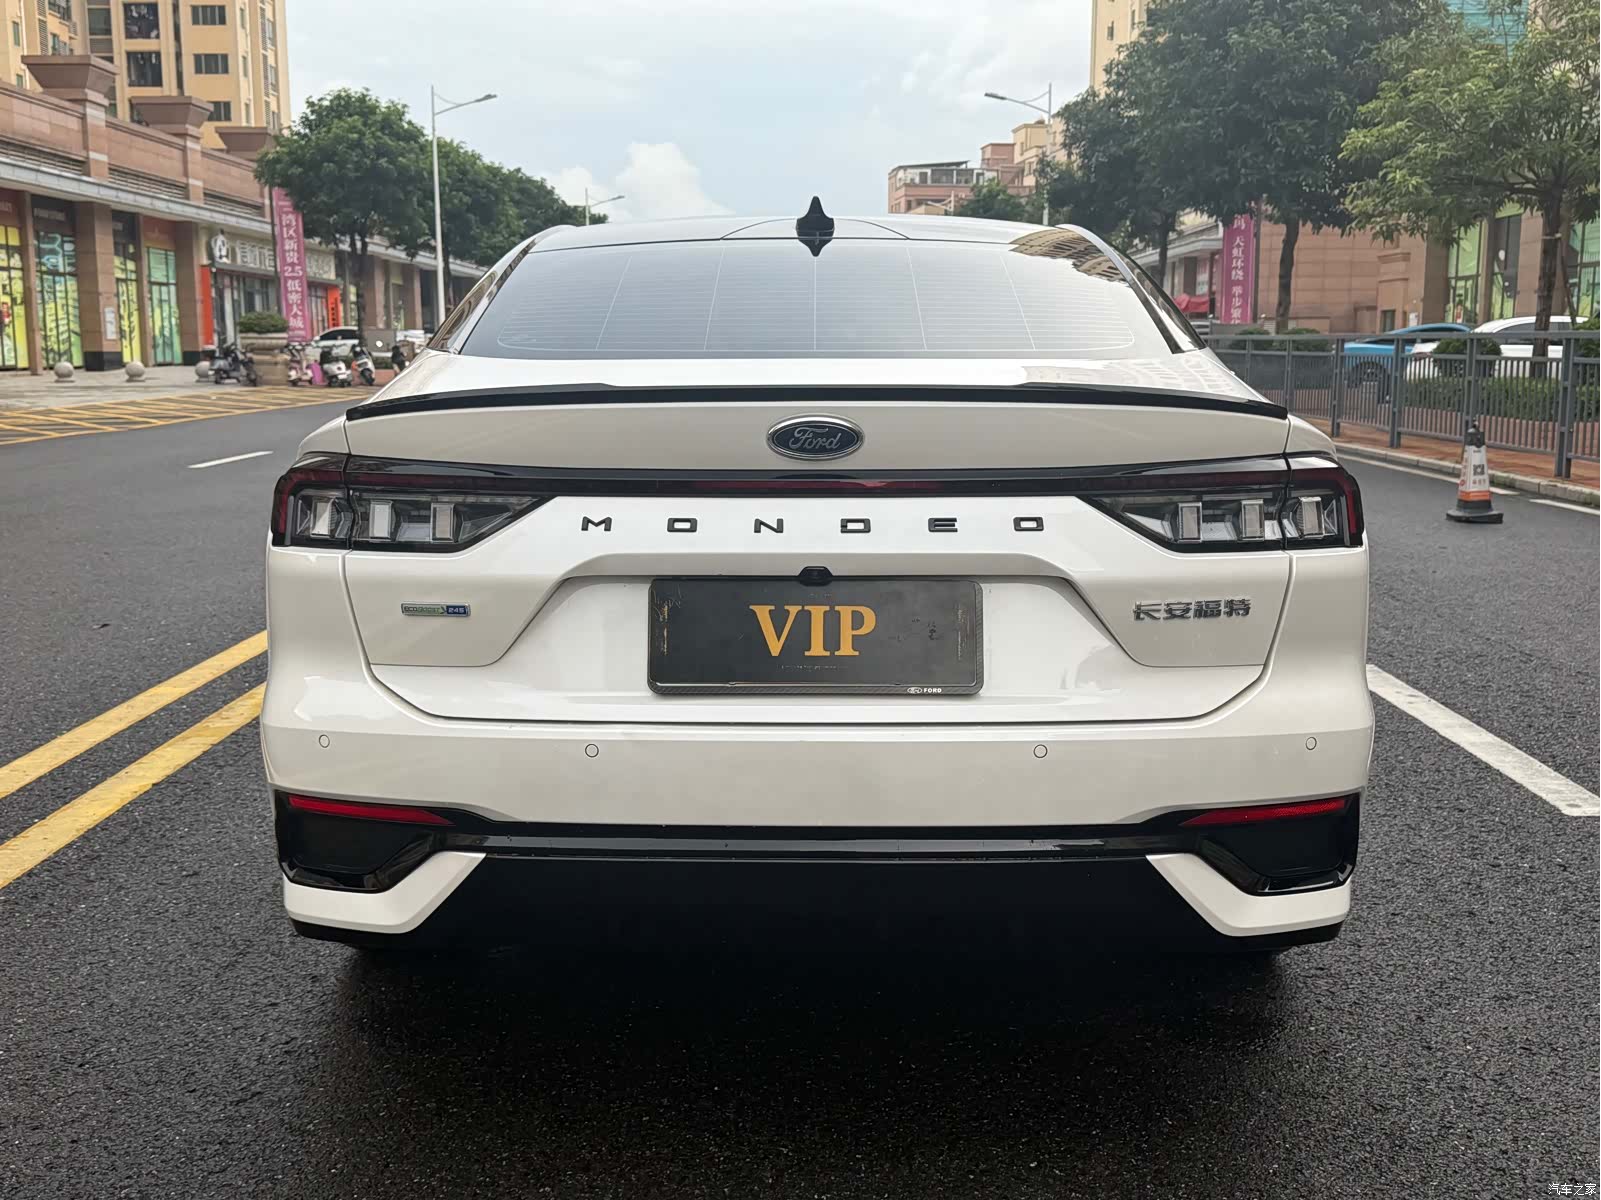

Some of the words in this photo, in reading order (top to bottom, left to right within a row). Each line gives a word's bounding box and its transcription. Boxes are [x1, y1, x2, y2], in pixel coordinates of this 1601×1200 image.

[789, 427, 841, 449] Ford
[581, 516, 1044, 533] MONDEO
[448, 606, 465, 614] 245
[1133, 599, 1251, 620] 长安福特
[749, 605, 876, 656] VIP
